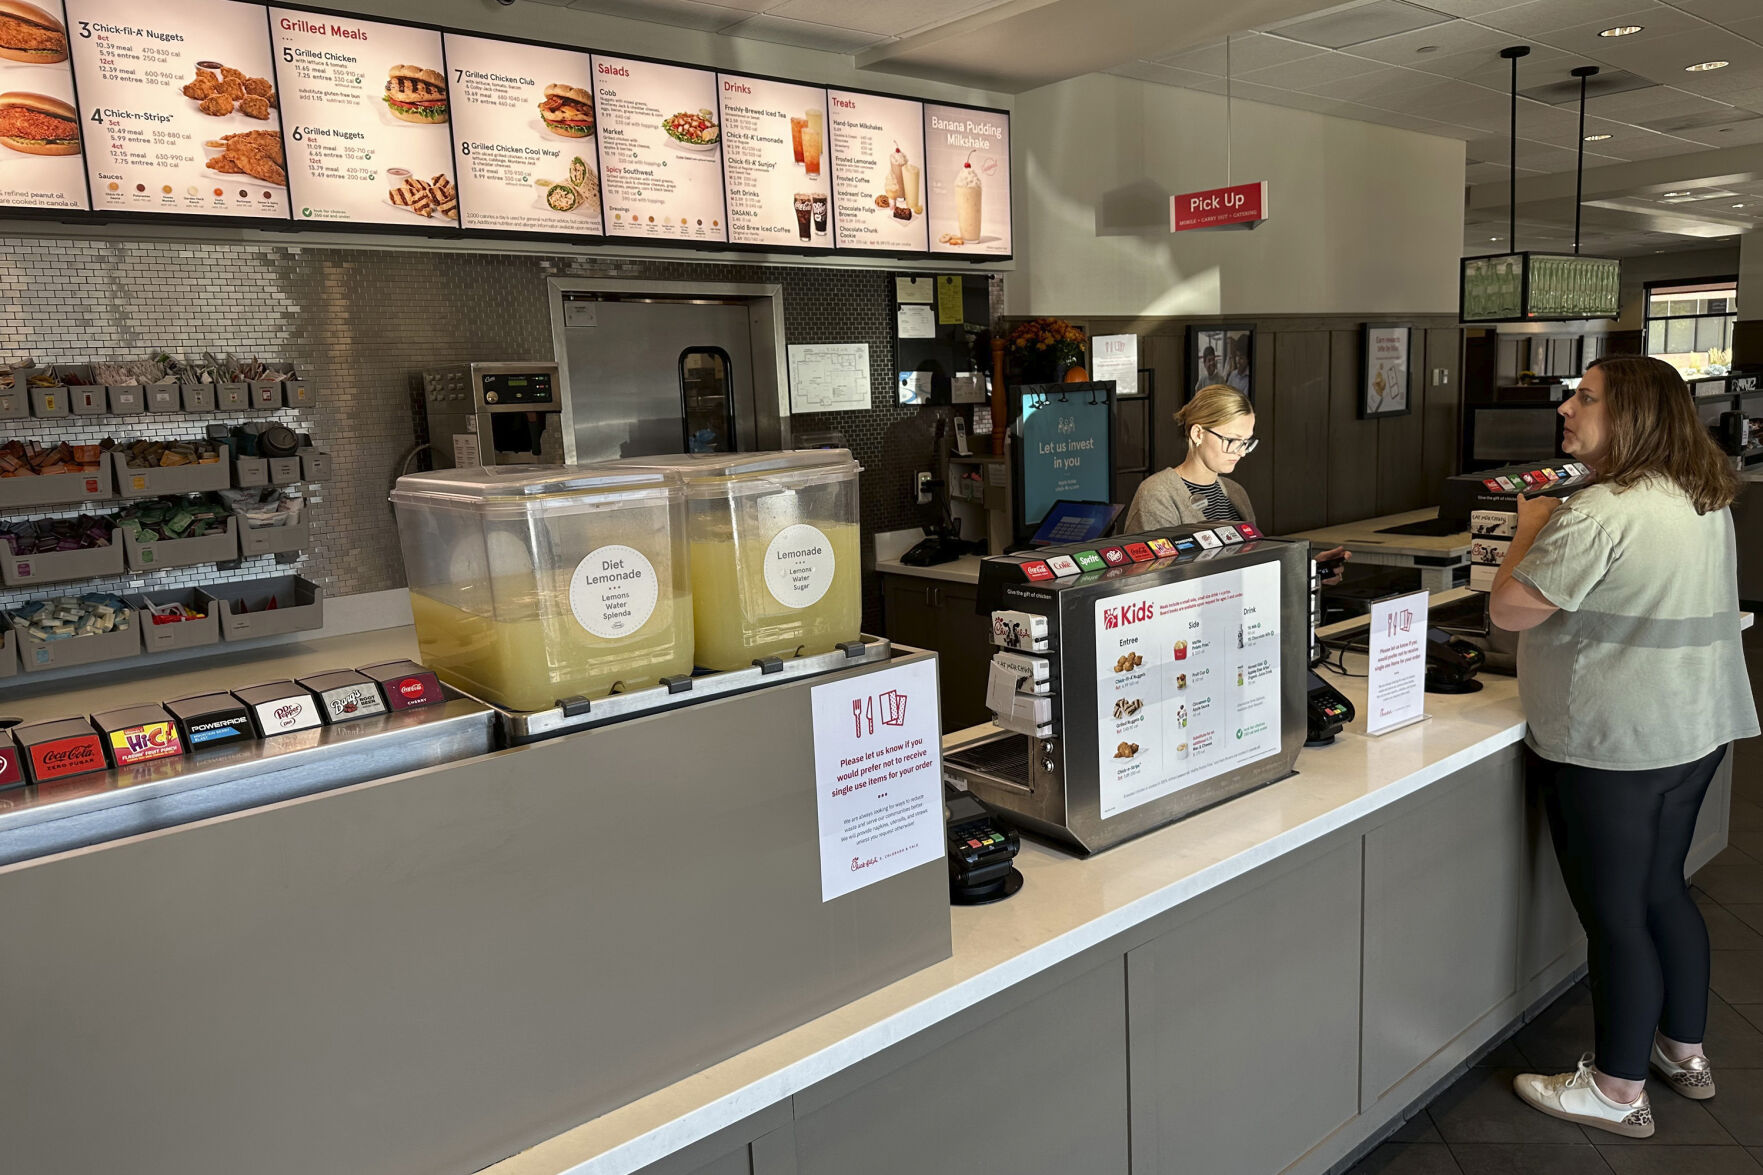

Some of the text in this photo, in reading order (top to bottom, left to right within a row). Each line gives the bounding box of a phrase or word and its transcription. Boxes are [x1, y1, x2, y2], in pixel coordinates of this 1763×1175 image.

[78, 22, 92, 38] 3
[146, 30, 184, 42] Nuggets
[280, 18, 368, 40] Grilled Meals
[117, 52, 140, 60] entree
[284, 48, 357, 63] 5 Grilled Chicken
[599, 64, 629, 77] Salads
[455, 69, 534, 86] 7 Grilled Chicken Club
[600, 89, 616, 97] Cobb
[724, 81, 751, 94] Drinks
[832, 97, 855, 109] Treats
[91, 108, 103, 124] 4
[293, 126, 364, 141] 6 Grilled Nuggets
[932, 117, 1002, 139] Banana Pudding
[757, 135, 783, 144] Lemonade
[948, 134, 989, 149] Milkshake
[462, 142, 470, 155] 8
[472, 142, 494, 151] Grilled
[496, 144, 522, 154] Chicken
[606, 166, 653, 176] Spicy Southwest
[4, 190, 29, 198] refined
[30, 192, 53, 200] peanut
[12, 198, 36, 206] cooked
[1190, 192, 1244, 212] Pick Up
[1039, 437, 1094, 454] Let us invest
[1054, 456, 1080, 470] in you
[777, 546, 822, 561] Lemonade
[602, 559, 624, 571] Diet
[1080, 555, 1099, 566] Sprite
[789, 566, 812, 575] Lemons
[586, 569, 642, 586] Lemonade
[793, 574, 810, 583] Water
[793, 583, 810, 591] Sugar
[601, 592, 630, 602] Lemons
[606, 601, 627, 611] Water
[1244, 607, 1256, 615] Drink
[603, 609, 632, 621] Splenda
[1121, 600, 1153, 626] Kids
[1189, 621, 1199, 629] Side
[1120, 637, 1138, 647] Entree
[331, 690, 361, 715] Barq's
[276, 706, 301, 720] Pepper
[192, 716, 247, 732] POWERADE
[840, 738, 923, 768] Please let us know if you
[47, 758, 94, 771] ZERO SUGAR
[837, 768, 859, 782] would
[860, 763, 881, 777] prefer
[883, 759, 894, 768] not
[904, 749, 927, 761] receive
[832, 760, 933, 797] single use items for your order
